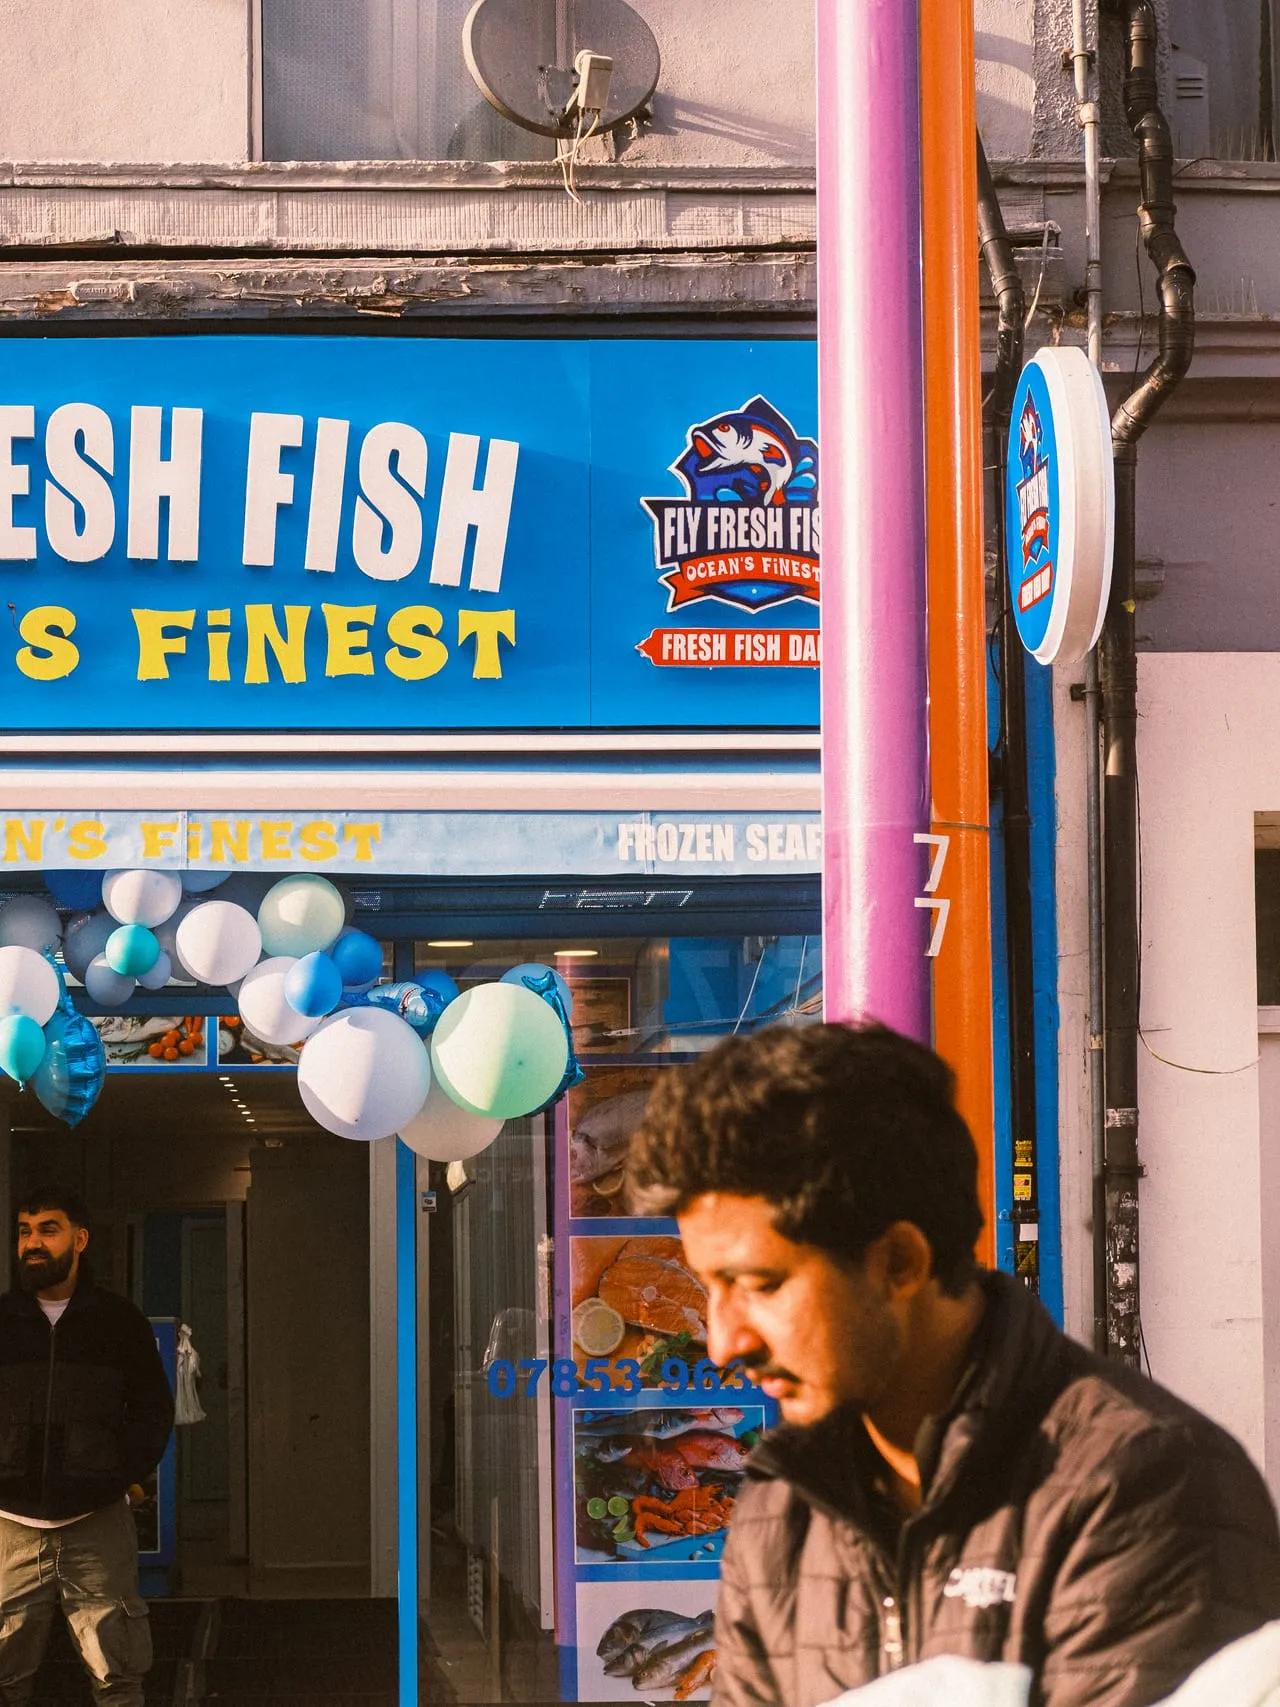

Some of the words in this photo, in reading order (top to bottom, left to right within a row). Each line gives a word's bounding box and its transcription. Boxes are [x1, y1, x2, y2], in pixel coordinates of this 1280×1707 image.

[242, 412, 520, 593] FISH
[664, 507, 701, 558] FLY
[707, 506, 783, 550] FRESH
[686, 556, 755, 582] OCEAN'S
[662, 633, 726, 661] FRESH
[734, 634, 781, 661] FISH
[618, 823, 734, 861] FROZEN
[487, 1358, 642, 1398] 07853
